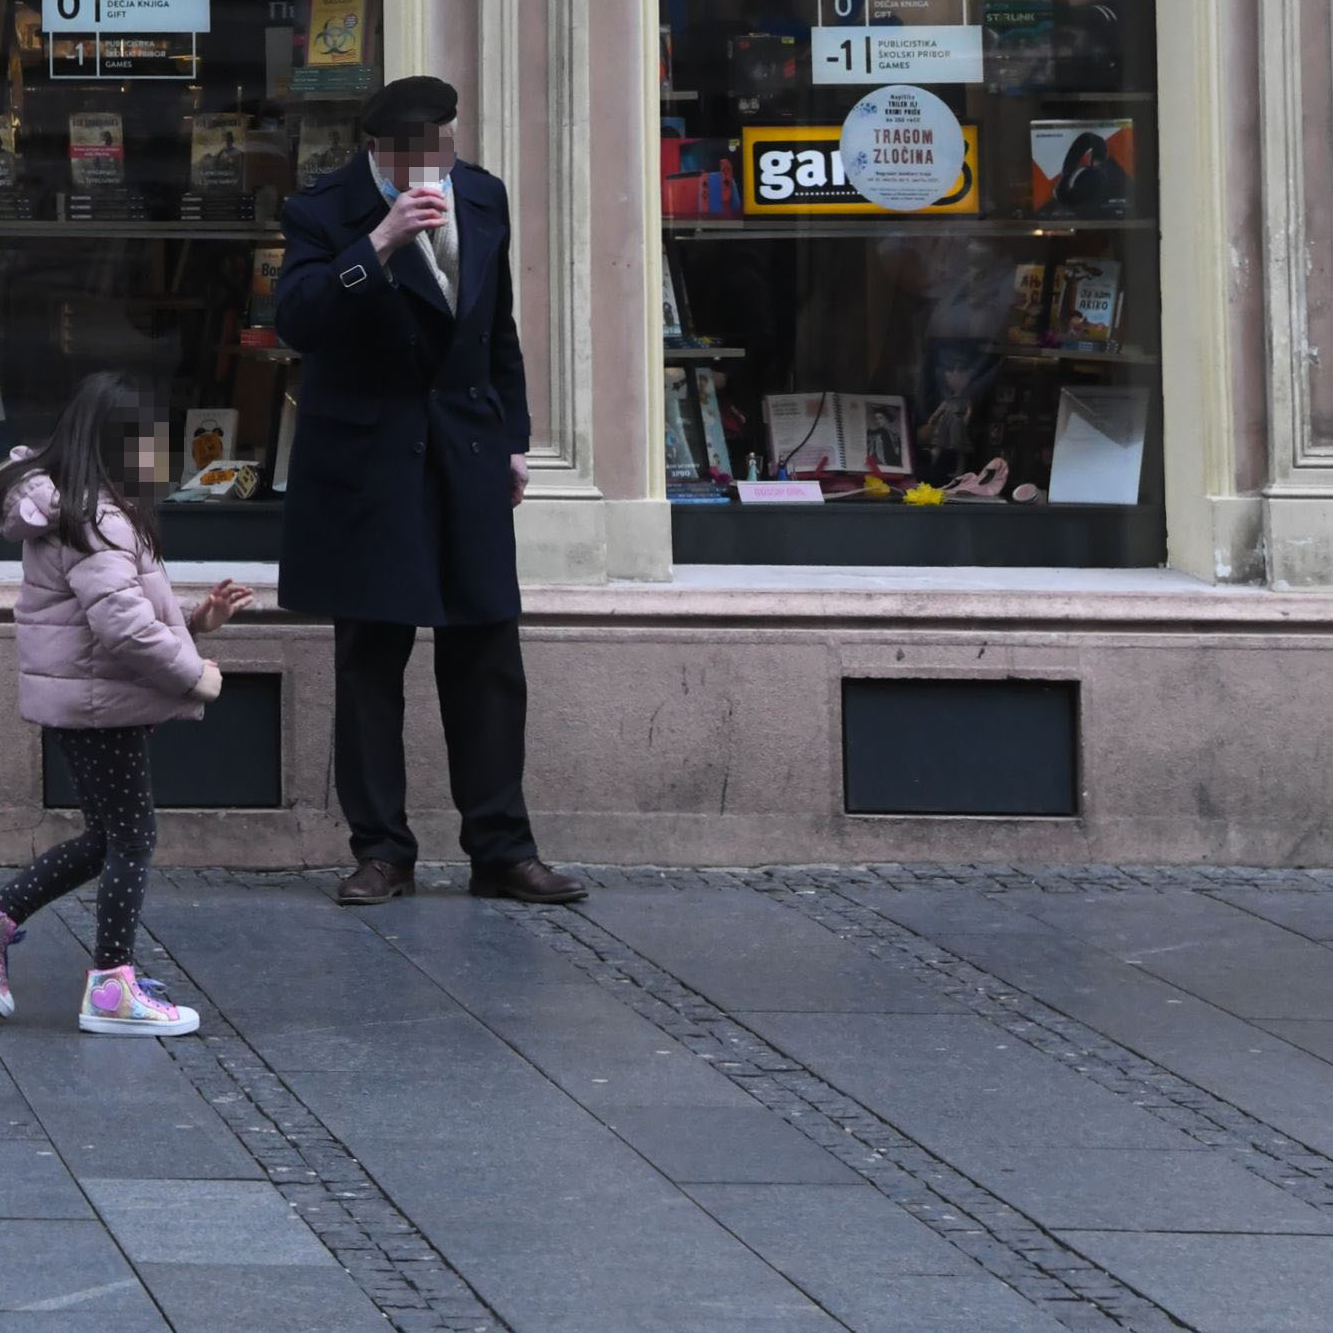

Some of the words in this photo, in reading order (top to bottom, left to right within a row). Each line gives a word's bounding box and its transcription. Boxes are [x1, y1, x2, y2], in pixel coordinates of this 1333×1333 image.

[137, 0, 170, 9] KNJIGA
[900, 0, 929, 8] KNJIGA
[107, 11, 127, 19] GIFT
[874, 10, 892, 18] GIFT
[878, 40, 937, 49] PUBLICISTIKA
[826, 39, 852, 71] -1
[878, 48, 915, 58] ŠKOLSKI
[917, 50, 951, 58] PRIBOR
[105, 60, 132, 68] GAMES
[879, 61, 910, 69] GAMES
[874, 128, 934, 145] TRAGOM
[873, 146, 935, 165] ZLOČINA
[1078, 300, 1109, 311] AKIKO
